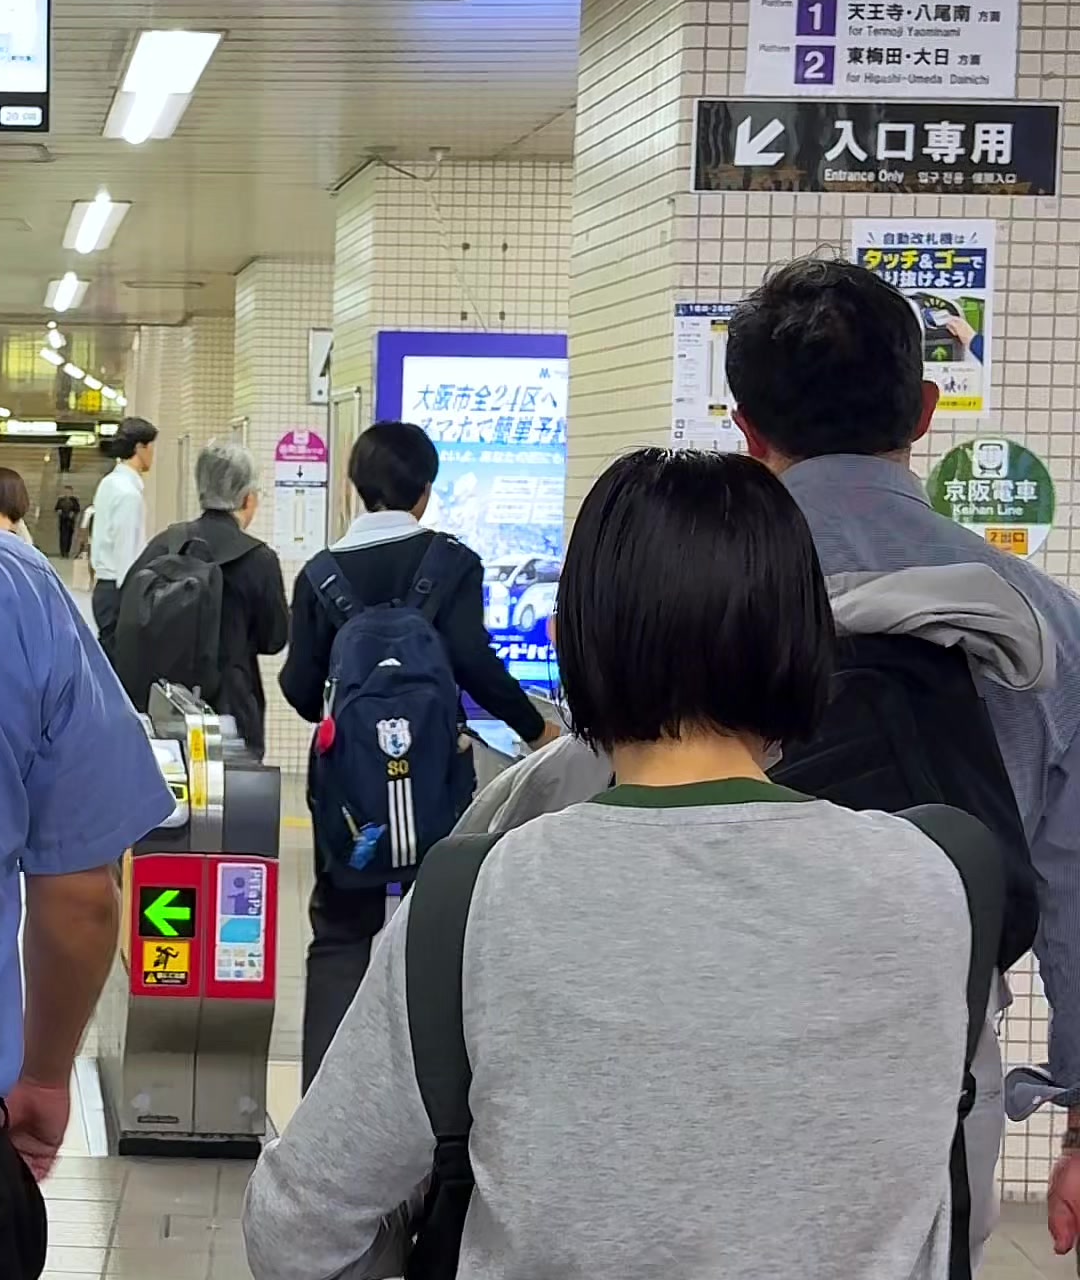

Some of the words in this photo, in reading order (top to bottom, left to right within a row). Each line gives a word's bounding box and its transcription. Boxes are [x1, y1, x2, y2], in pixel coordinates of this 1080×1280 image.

[808, 2, 823, 31] 1
[847, 3, 971, 23] 天王寺・八尾南
[978, 11, 1001, 23] 方面
[848, 25, 864, 36] for
[803, 51, 826, 79] 2
[846, 47, 950, 66] 東梅田・大日
[846, 72, 861, 83] for
[823, 119, 1015, 165] 入口専用
[824, 169, 875, 183] Entrance
[878, 169, 905, 185] Only
[883, 231, 965, 245] 自動改札機は
[863, 249, 984, 270] タッチ&ゴーで
[874, 270, 975, 288] り抜けよう!
[413, 384, 558, 412] 大阪市全24区へ
[943, 478, 1038, 503] 京阪電車
[953, 503, 994, 516] Keihan
[997, 503, 1024, 516] Line
